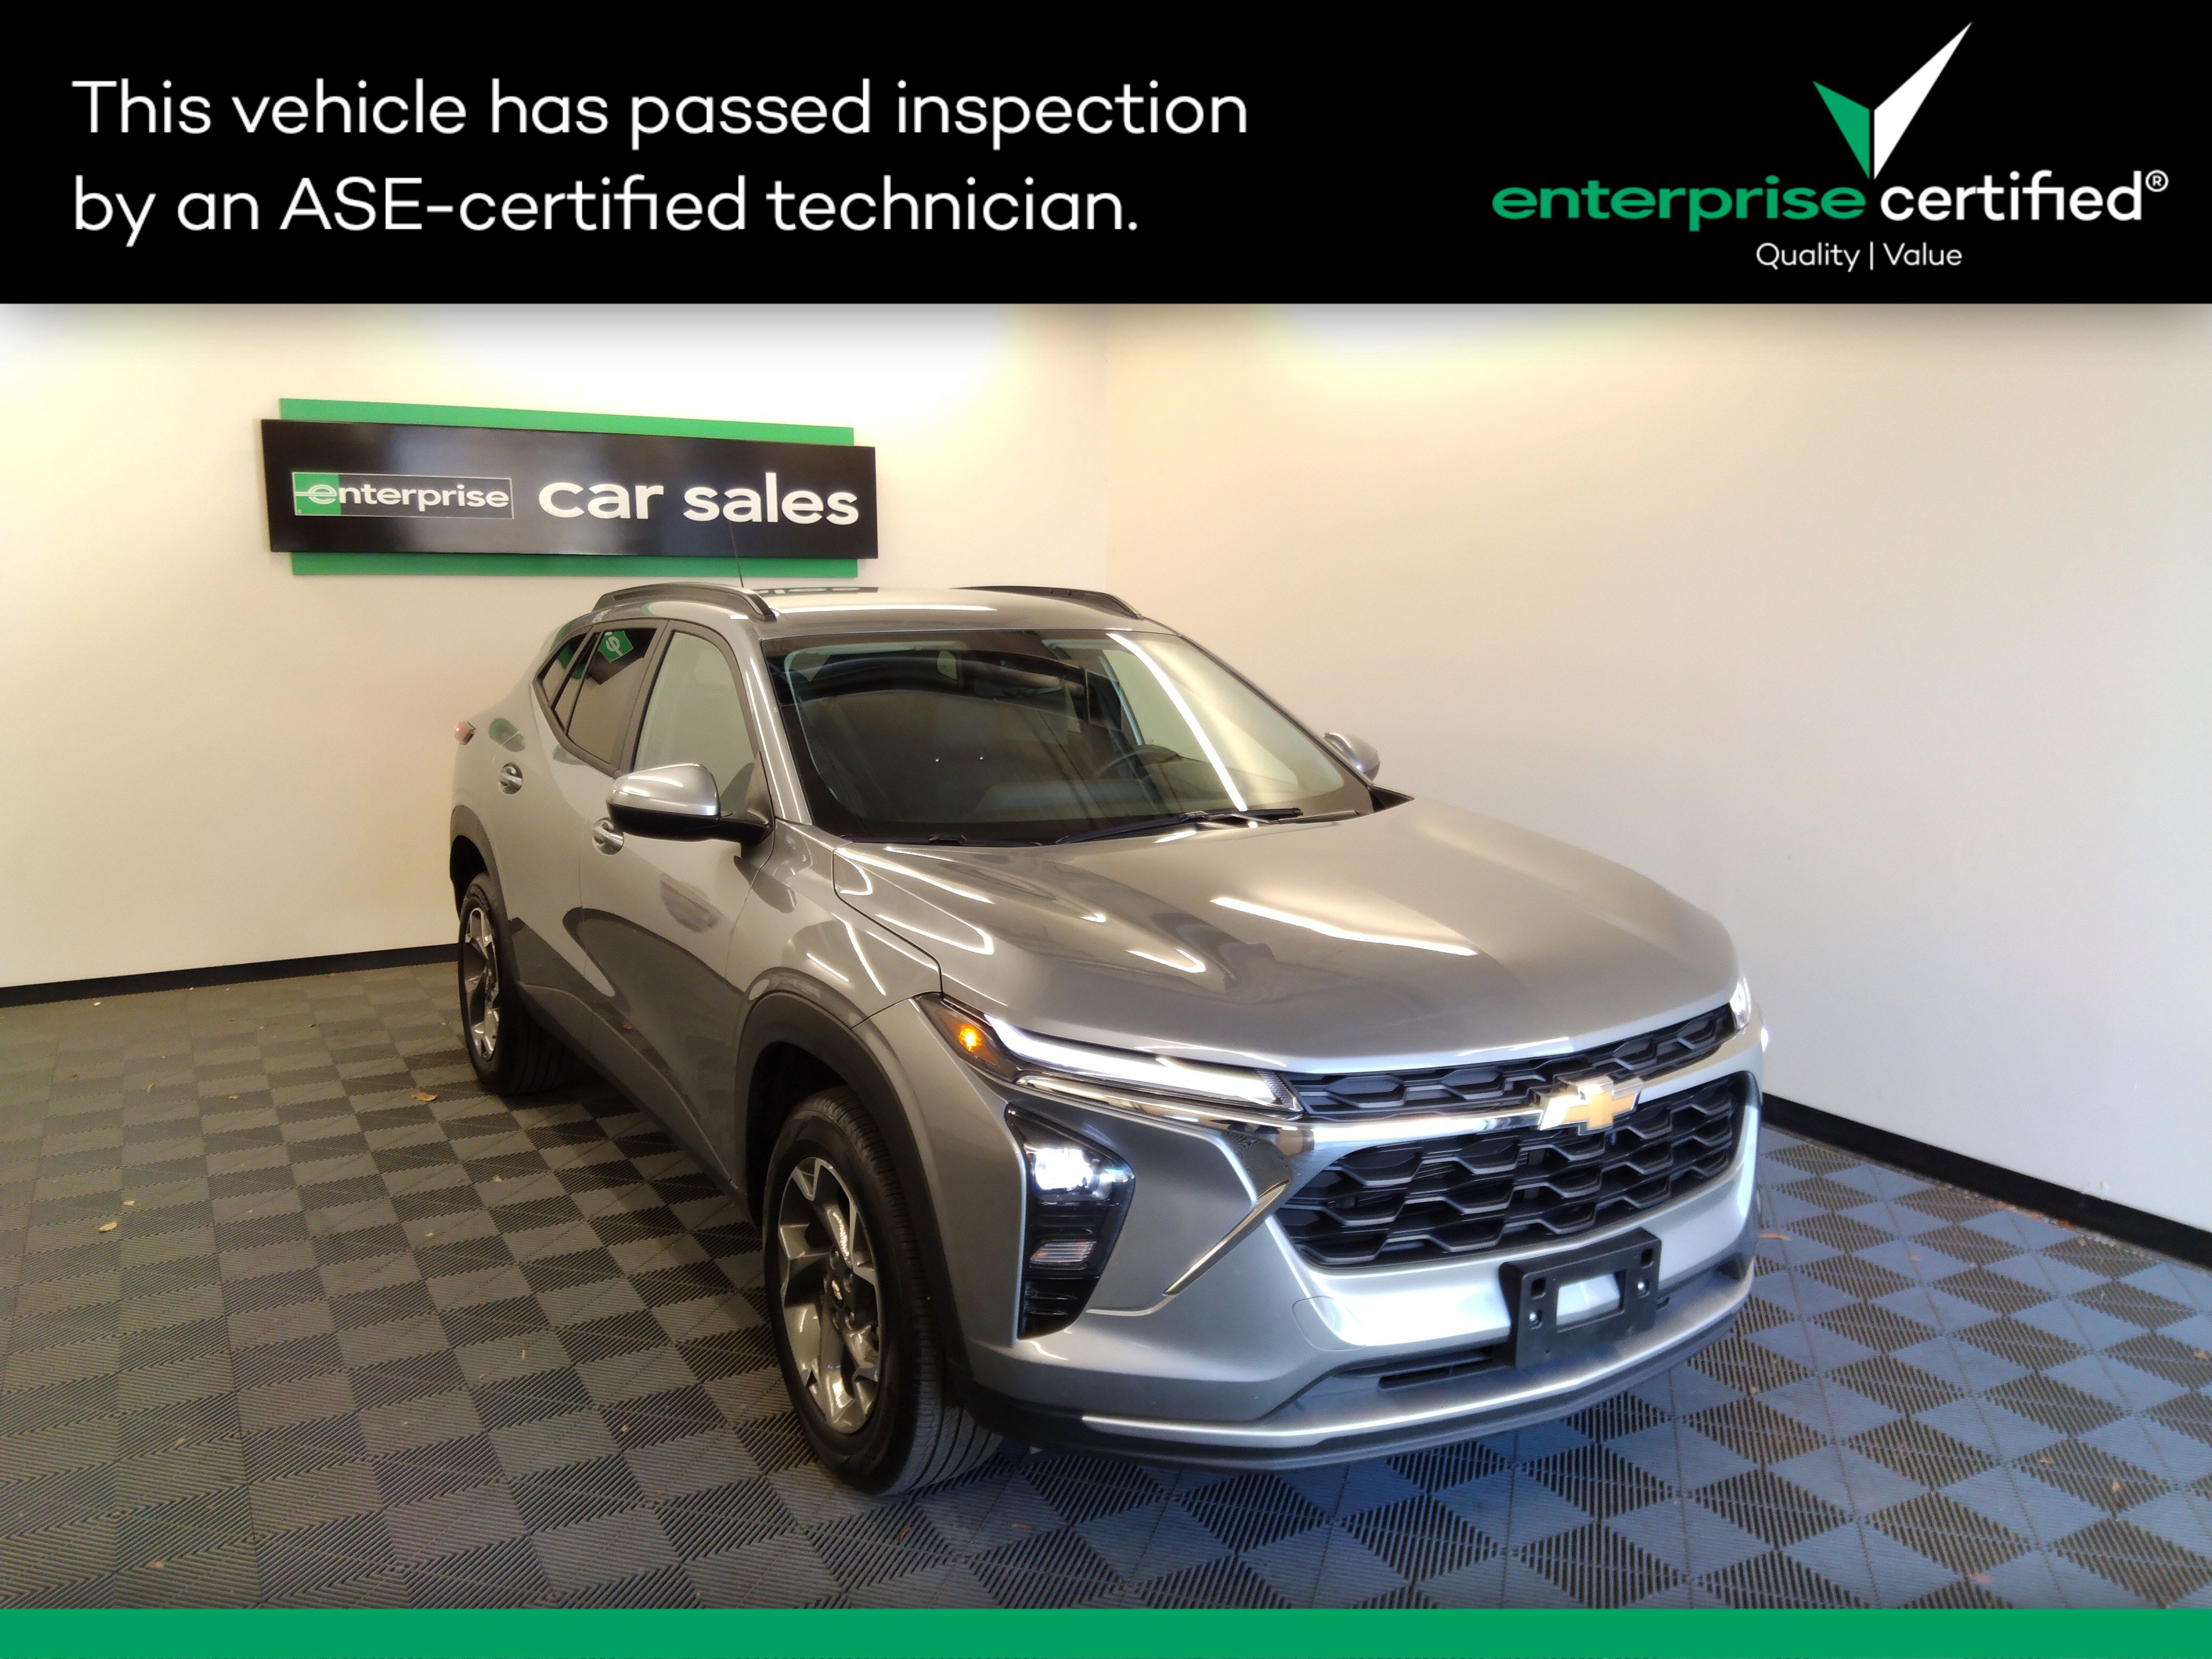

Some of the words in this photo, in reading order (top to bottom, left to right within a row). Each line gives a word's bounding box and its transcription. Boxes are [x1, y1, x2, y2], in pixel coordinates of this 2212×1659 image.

[306, 484, 509, 512] enterprise
[539, 477, 664, 520] car
[683, 472, 859, 525] sales
